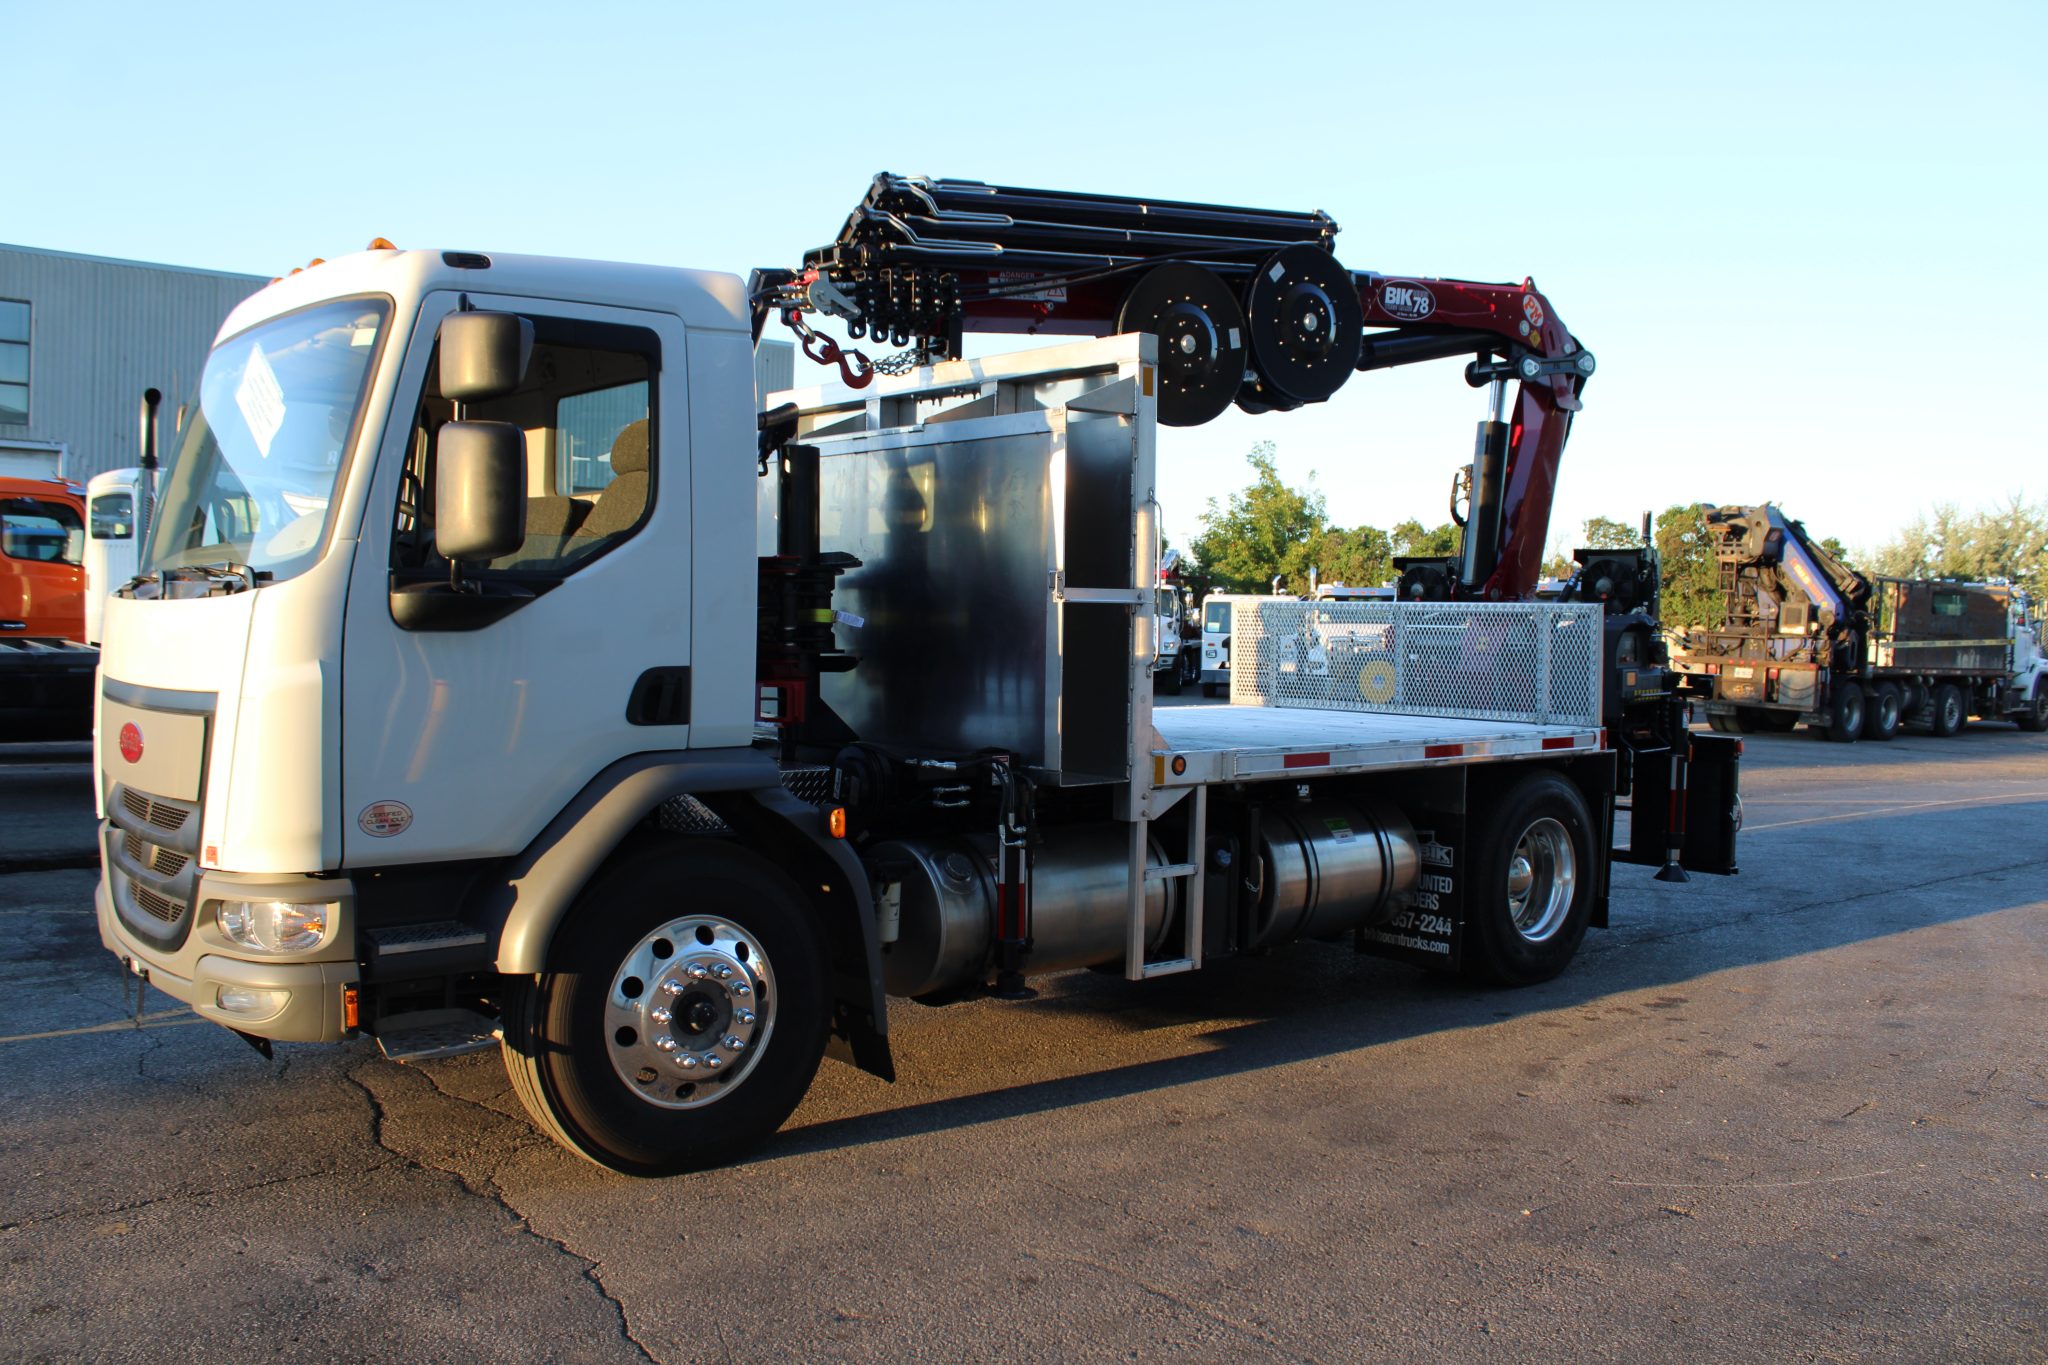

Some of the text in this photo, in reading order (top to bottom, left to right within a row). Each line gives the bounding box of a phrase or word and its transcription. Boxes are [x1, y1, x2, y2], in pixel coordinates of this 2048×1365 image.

[1004, 271, 1036, 279] DANGER
[1385, 286, 1413, 306] BIK
[1413, 296, 1429, 314] 78
[1523, 295, 1543, 325] PM
